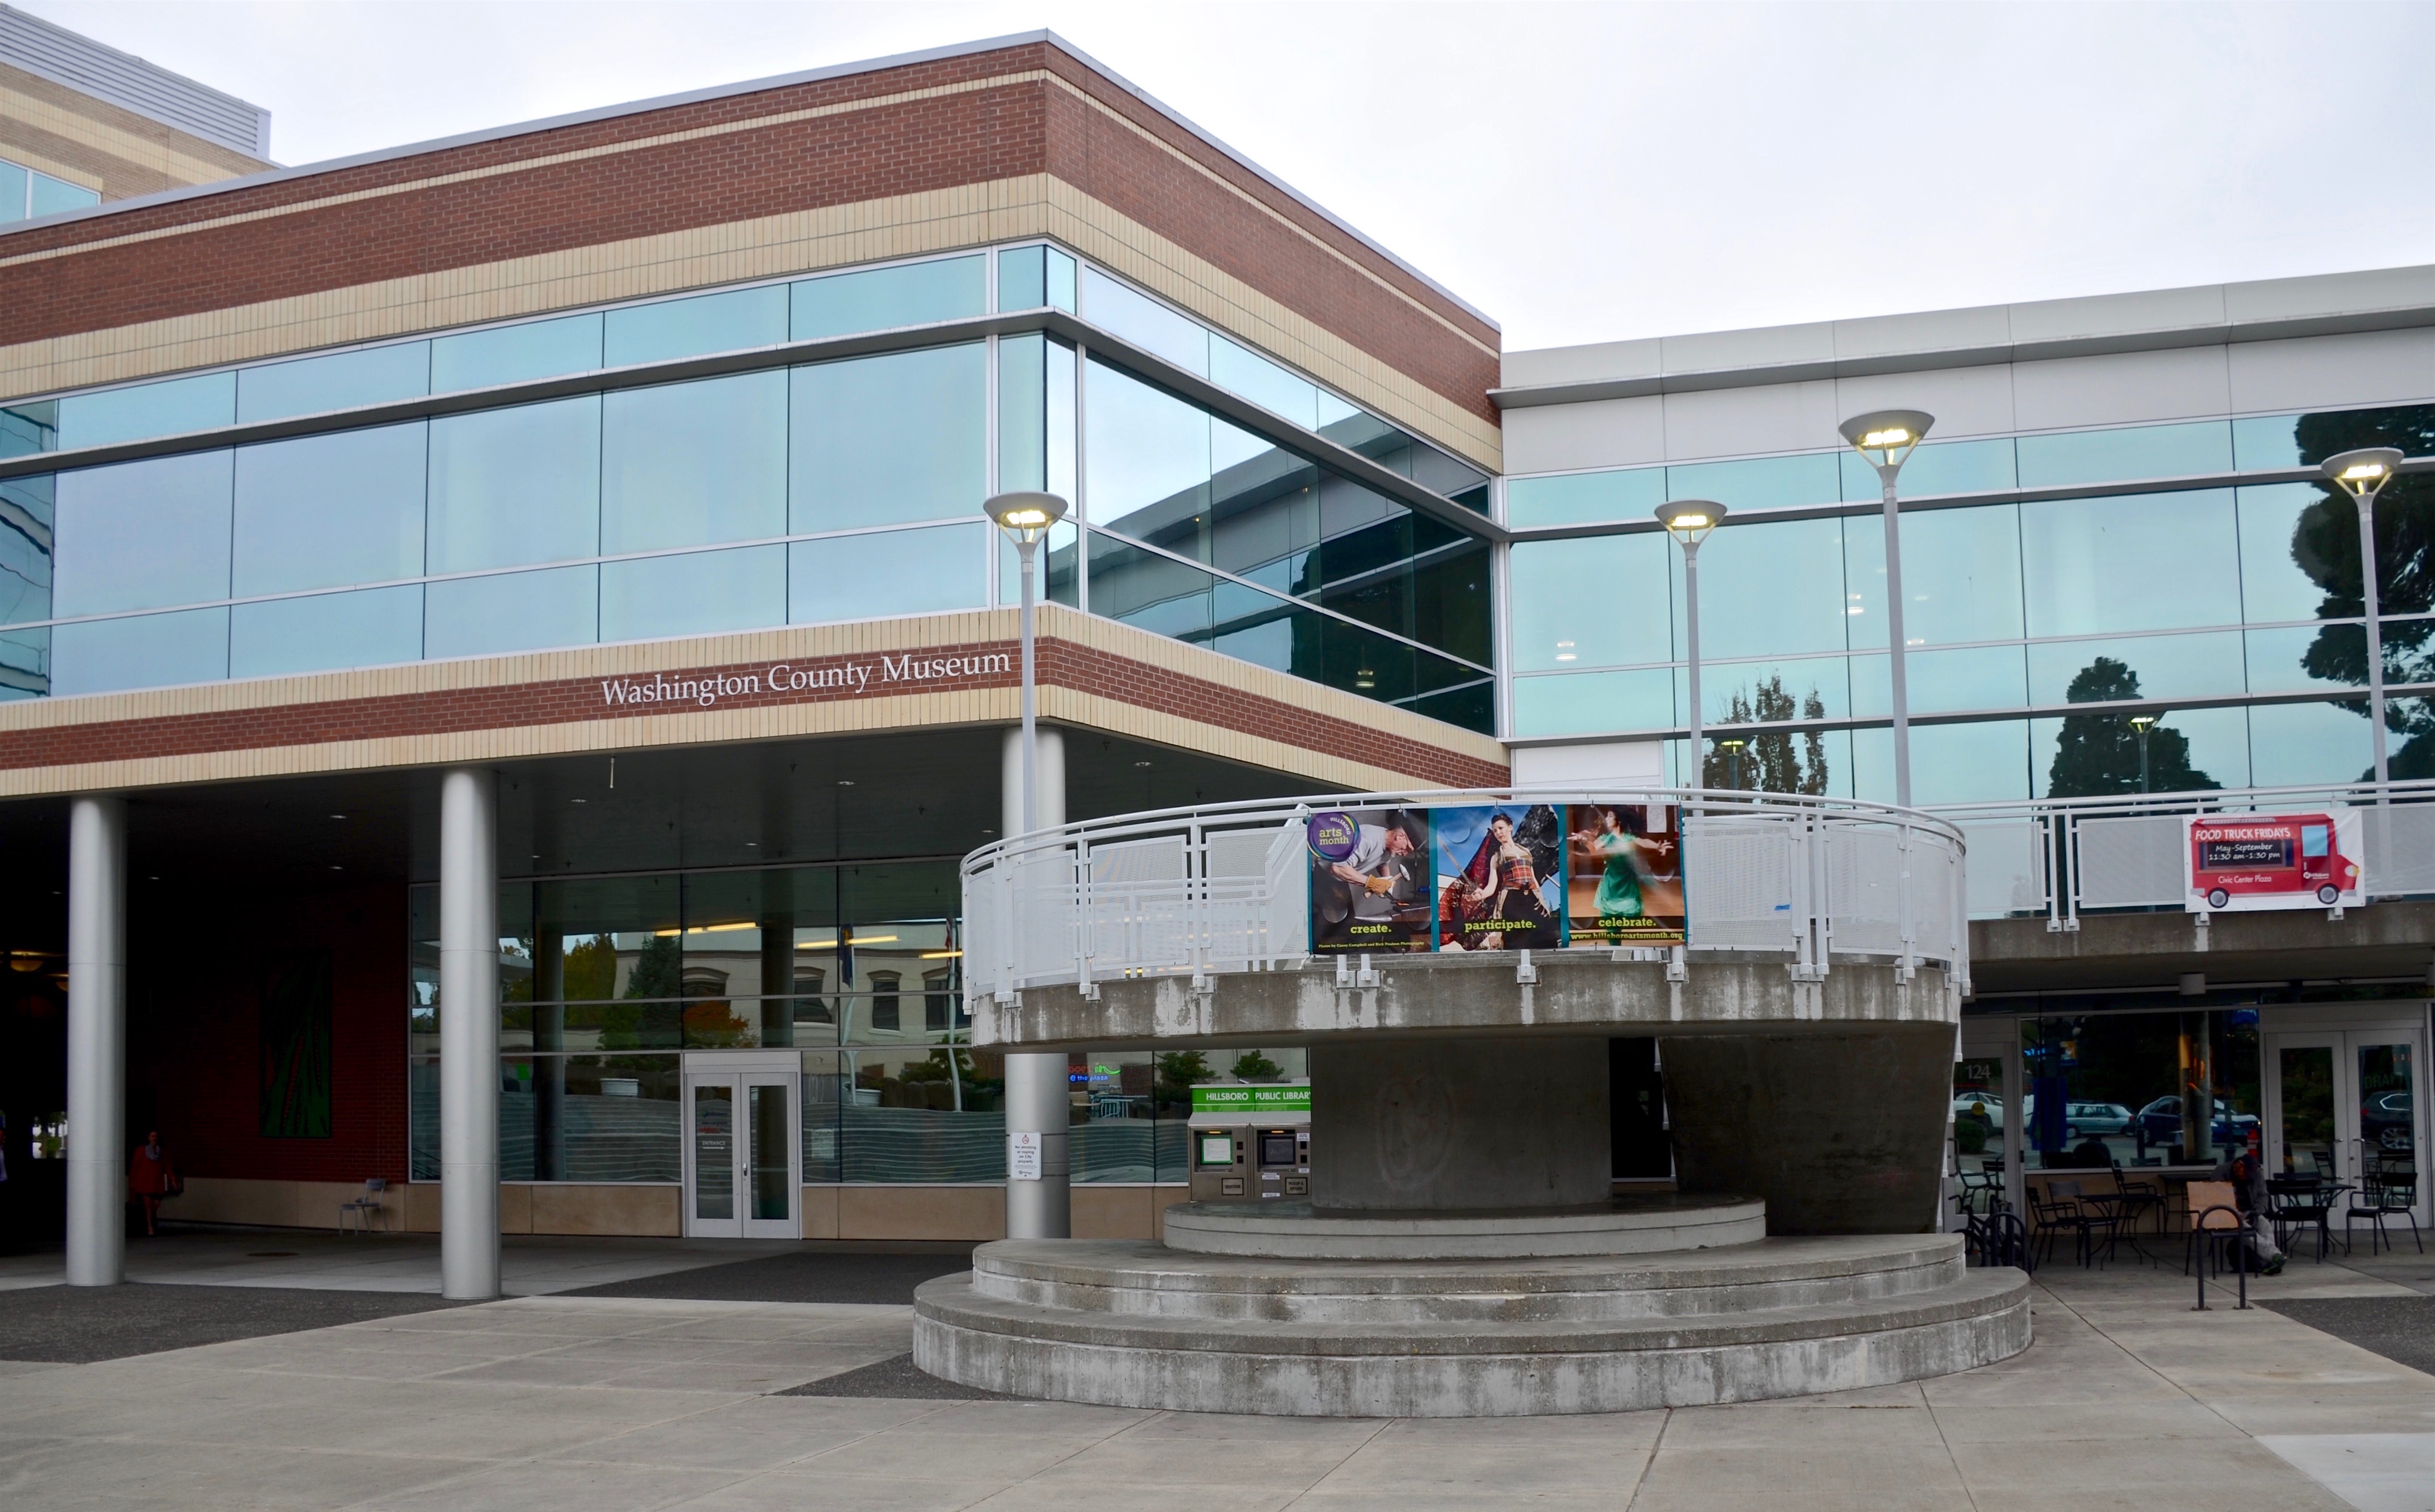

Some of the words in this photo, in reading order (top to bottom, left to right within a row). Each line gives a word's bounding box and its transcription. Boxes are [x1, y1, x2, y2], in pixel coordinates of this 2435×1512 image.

[601, 673, 759, 706] Washington
[768, 662, 873, 693] County
[881, 653, 1011, 682] Museum
[1330, 817, 1351, 835] HILLSBORO
[1319, 827, 1342, 837] arts
[2195, 830, 2222, 841] FOOD
[2224, 829, 2252, 839] TRUCK
[2254, 827, 2291, 838] FRIDAYS
[1319, 836, 1349, 845] month
[2215, 843, 2273, 853] May-September
[2218, 875, 2233, 884] Civic
[1464, 919, 1536, 933] participate.
[1598, 917, 1656, 927] celebrate.
[1350, 924, 1392, 934] create.
[1571, 931, 1683, 940] www.hillsboroartsmonth.org
[1965, 1064, 1991, 1079] 124
[1206, 1092, 1249, 1101] HILLSBORO
[1255, 1091, 1281, 1100] PUBLIC
